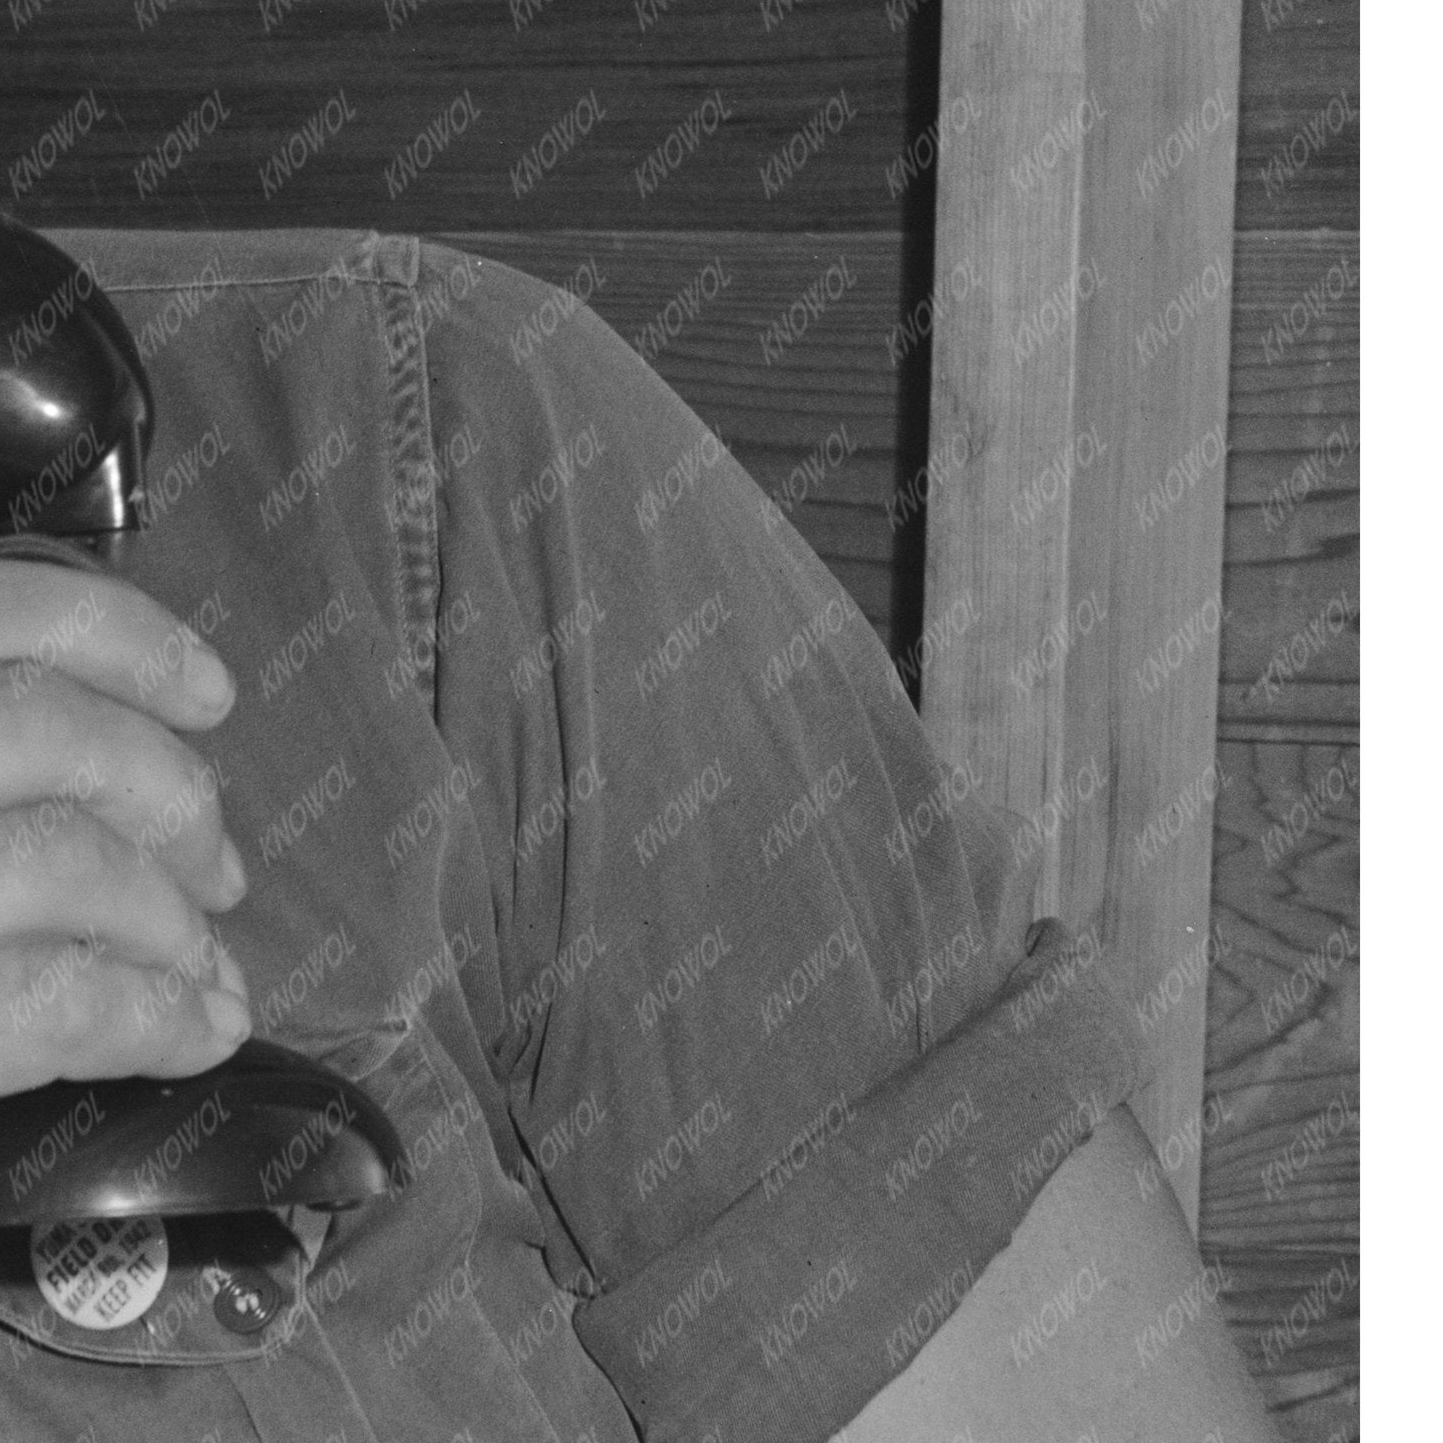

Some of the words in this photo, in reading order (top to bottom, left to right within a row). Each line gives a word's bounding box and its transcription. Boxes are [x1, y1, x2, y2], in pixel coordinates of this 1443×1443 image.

[46, 1237, 98, 1294] FIELD
[93, 1279, 131, 1322] KEEP
[127, 1253, 157, 1288] FIT
